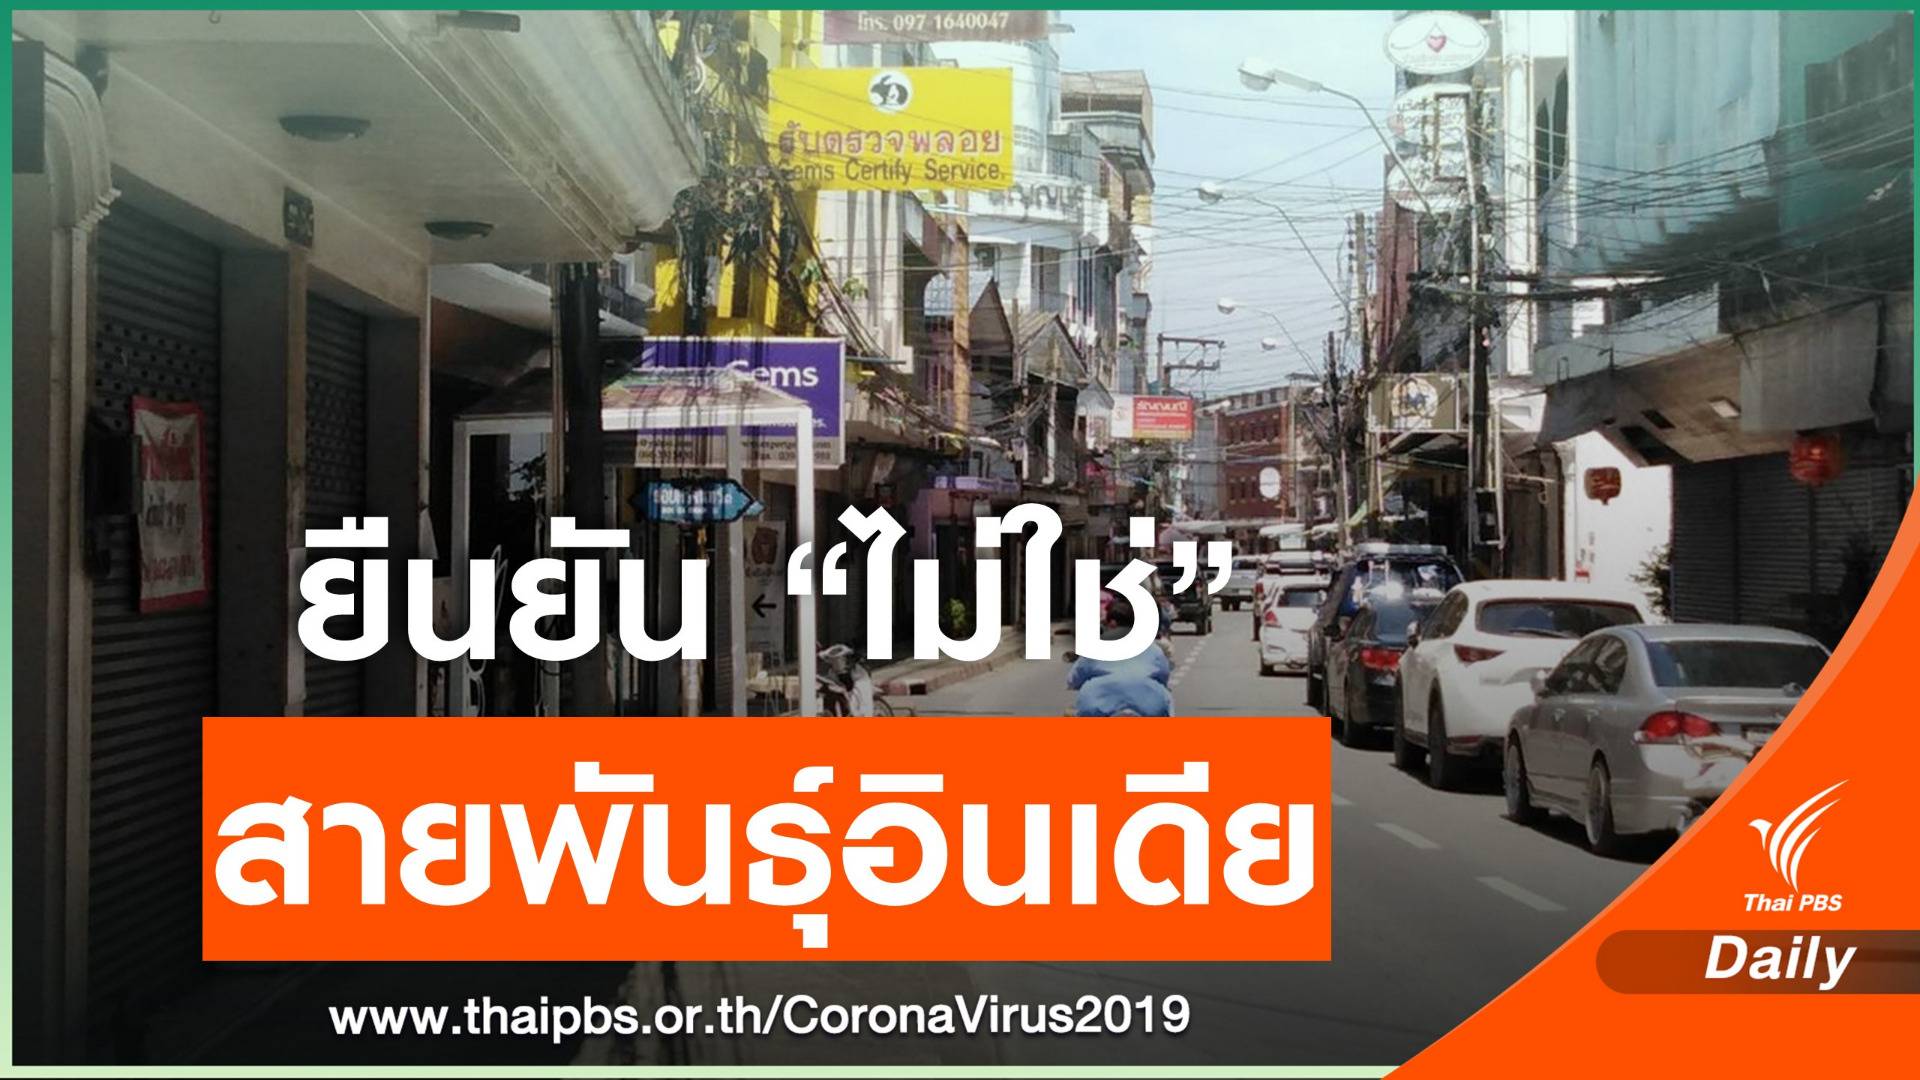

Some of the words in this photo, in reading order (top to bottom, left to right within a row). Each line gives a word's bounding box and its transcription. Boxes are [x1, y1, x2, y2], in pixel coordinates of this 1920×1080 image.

[893, 14, 925, 31] 097
[934, 11, 1009, 31] 1640047
[778, 120, 1000, 155] รับตรวจพลอย
[845, 157, 912, 184] Certify
